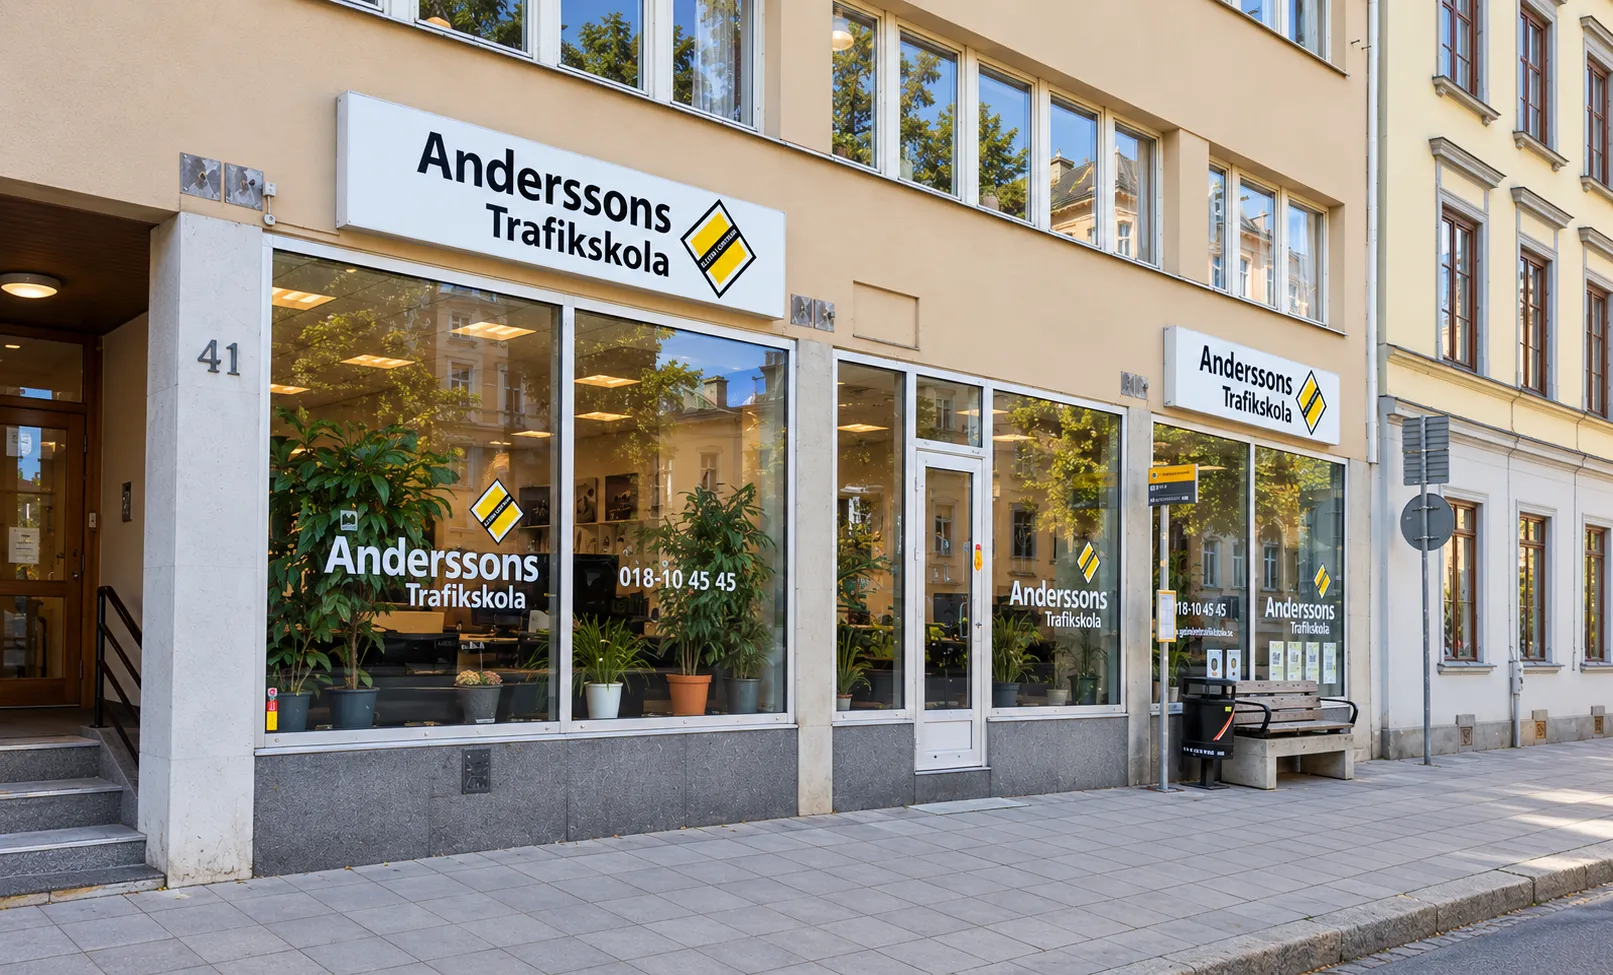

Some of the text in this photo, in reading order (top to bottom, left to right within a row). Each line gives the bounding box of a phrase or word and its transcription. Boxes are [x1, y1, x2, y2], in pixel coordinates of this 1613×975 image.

[417, 131, 671, 234] Anderssons
[485, 203, 669, 278] Trafikskola
[197, 339, 240, 377] 41
[1199, 344, 1293, 396] Anderssons
[1222, 385, 1292, 424] Trafikskola
[324, 535, 539, 582] Anderssons
[405, 582, 526, 609] Trafikskola
[619, 566, 736, 592] 018-10 45 45
[1009, 579, 1108, 610] Anderssons
[1044, 610, 1102, 628] Trafikskola
[1202, 602, 1215, 617] 45
[1215, 603, 1227, 617] 45
[1264, 596, 1335, 620] Anderssons
